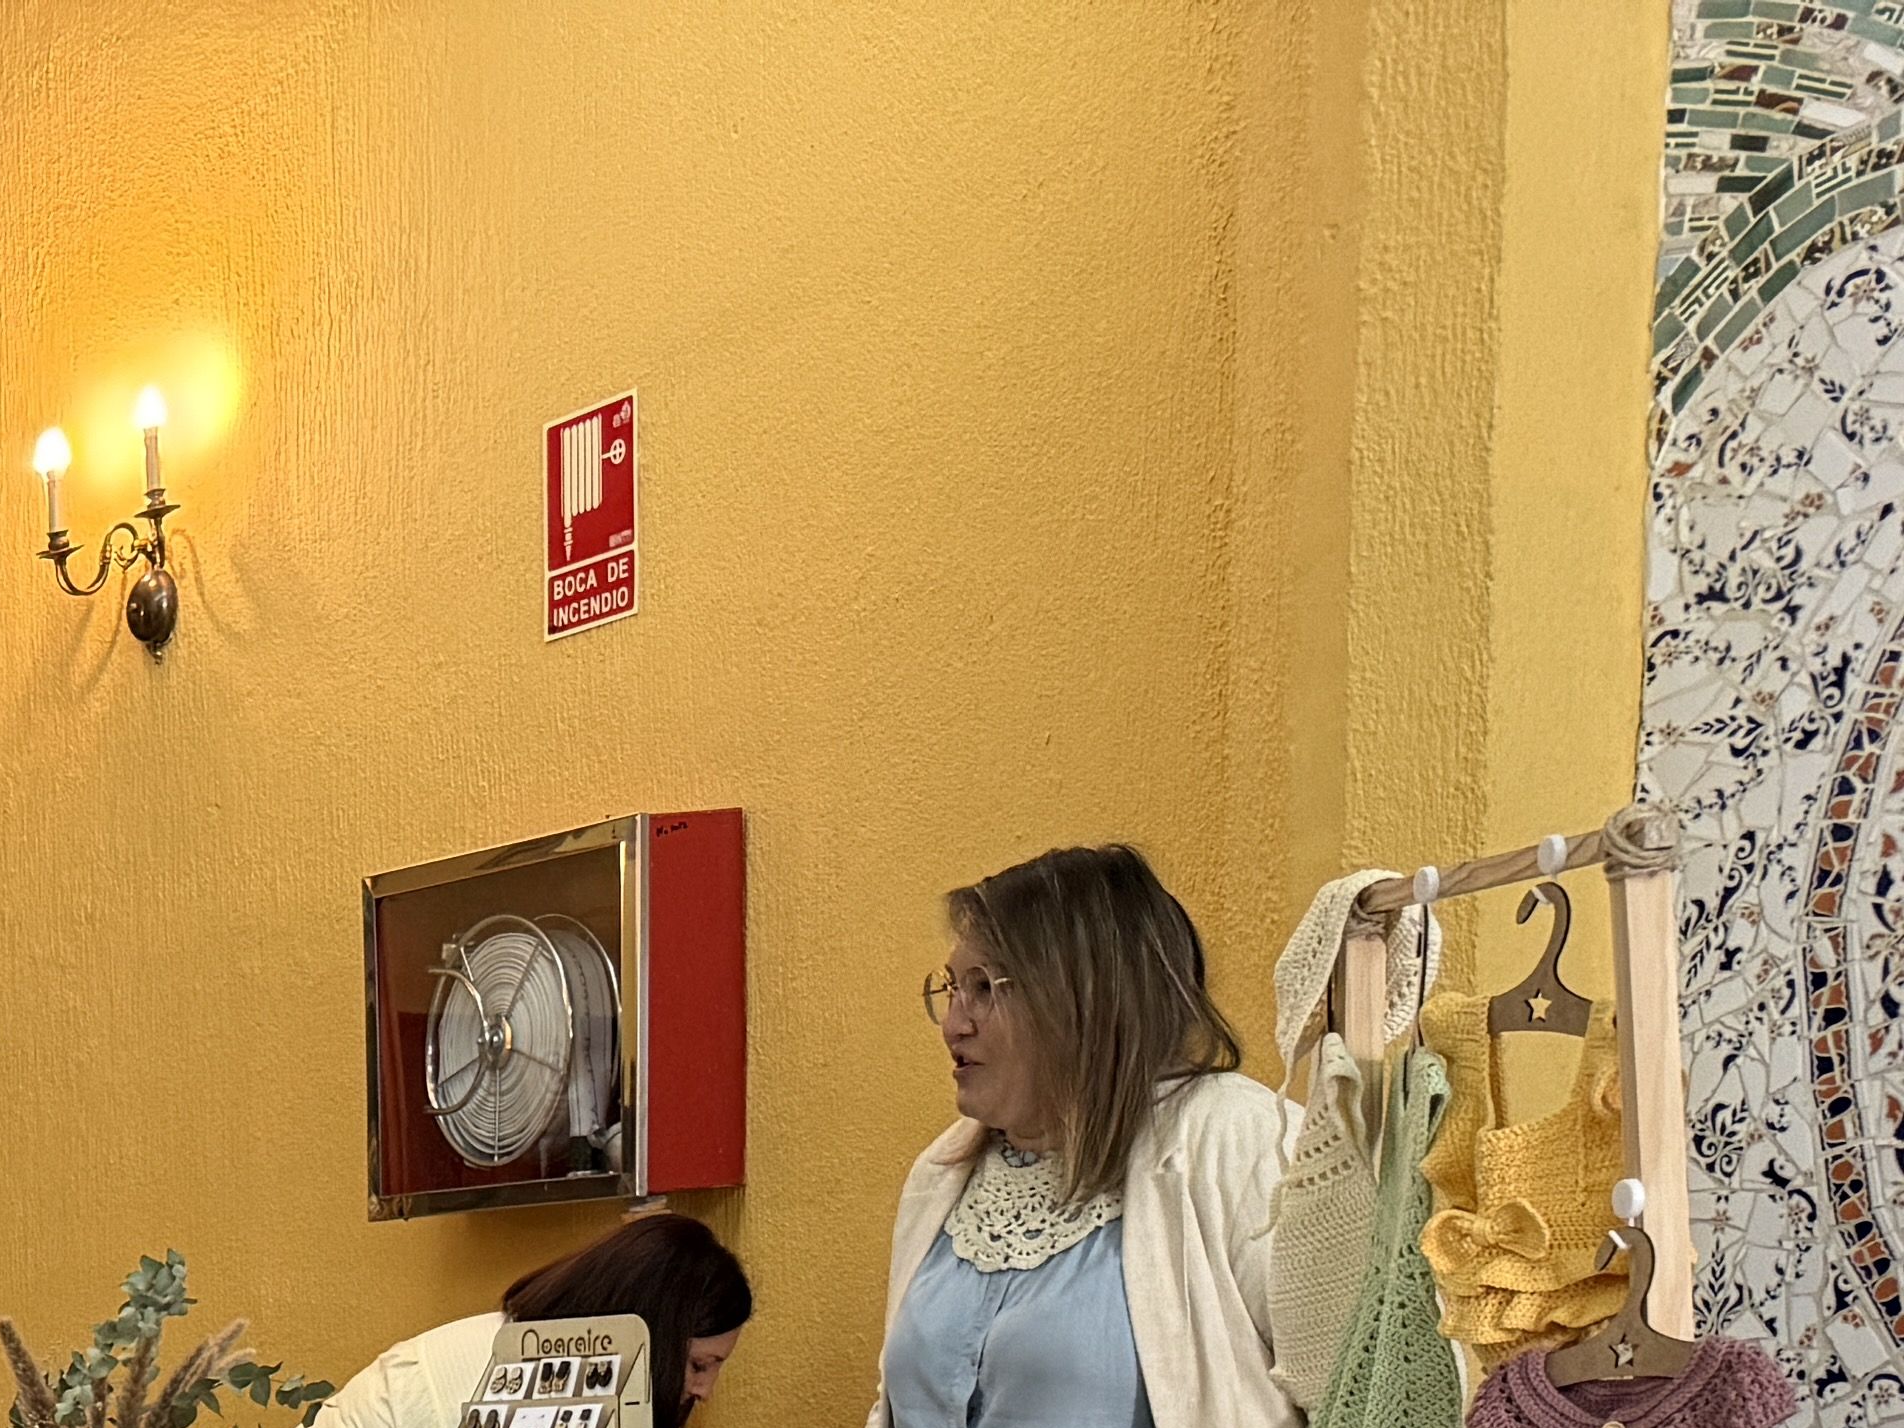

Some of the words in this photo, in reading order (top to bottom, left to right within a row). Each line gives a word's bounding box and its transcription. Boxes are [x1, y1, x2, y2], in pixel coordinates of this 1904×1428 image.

[553, 569, 597, 600] BOCA
[607, 557, 629, 582] DE
[553, 586, 629, 627] INCENDIO
